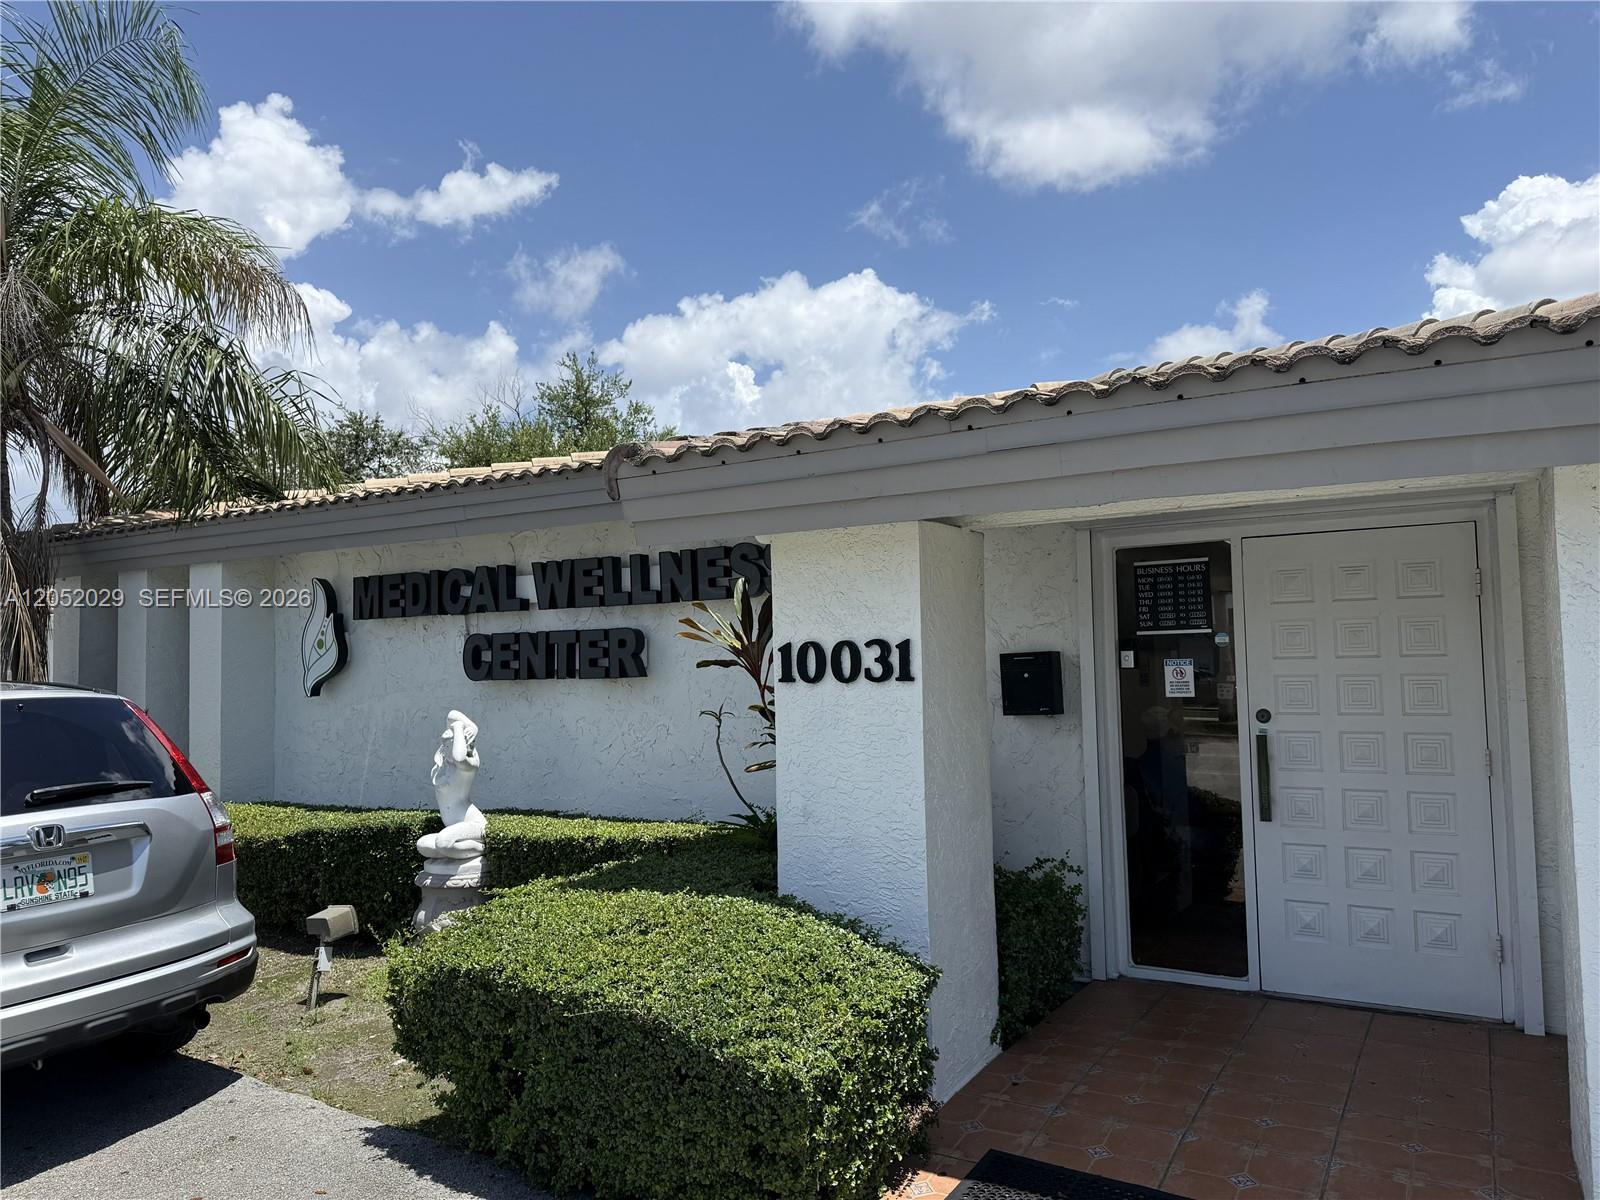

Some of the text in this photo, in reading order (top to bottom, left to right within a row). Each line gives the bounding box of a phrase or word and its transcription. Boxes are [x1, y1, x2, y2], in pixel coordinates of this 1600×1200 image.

[1136, 564, 1206, 575] BUSINESS HOURS
[353, 564, 529, 620] MEDICAL
[463, 627, 648, 681] CENTER
[777, 638, 915, 683] 10031
[2, 865, 88, 900] LAV N95
[20, 890, 74, 906] SUNSHINE STATE
